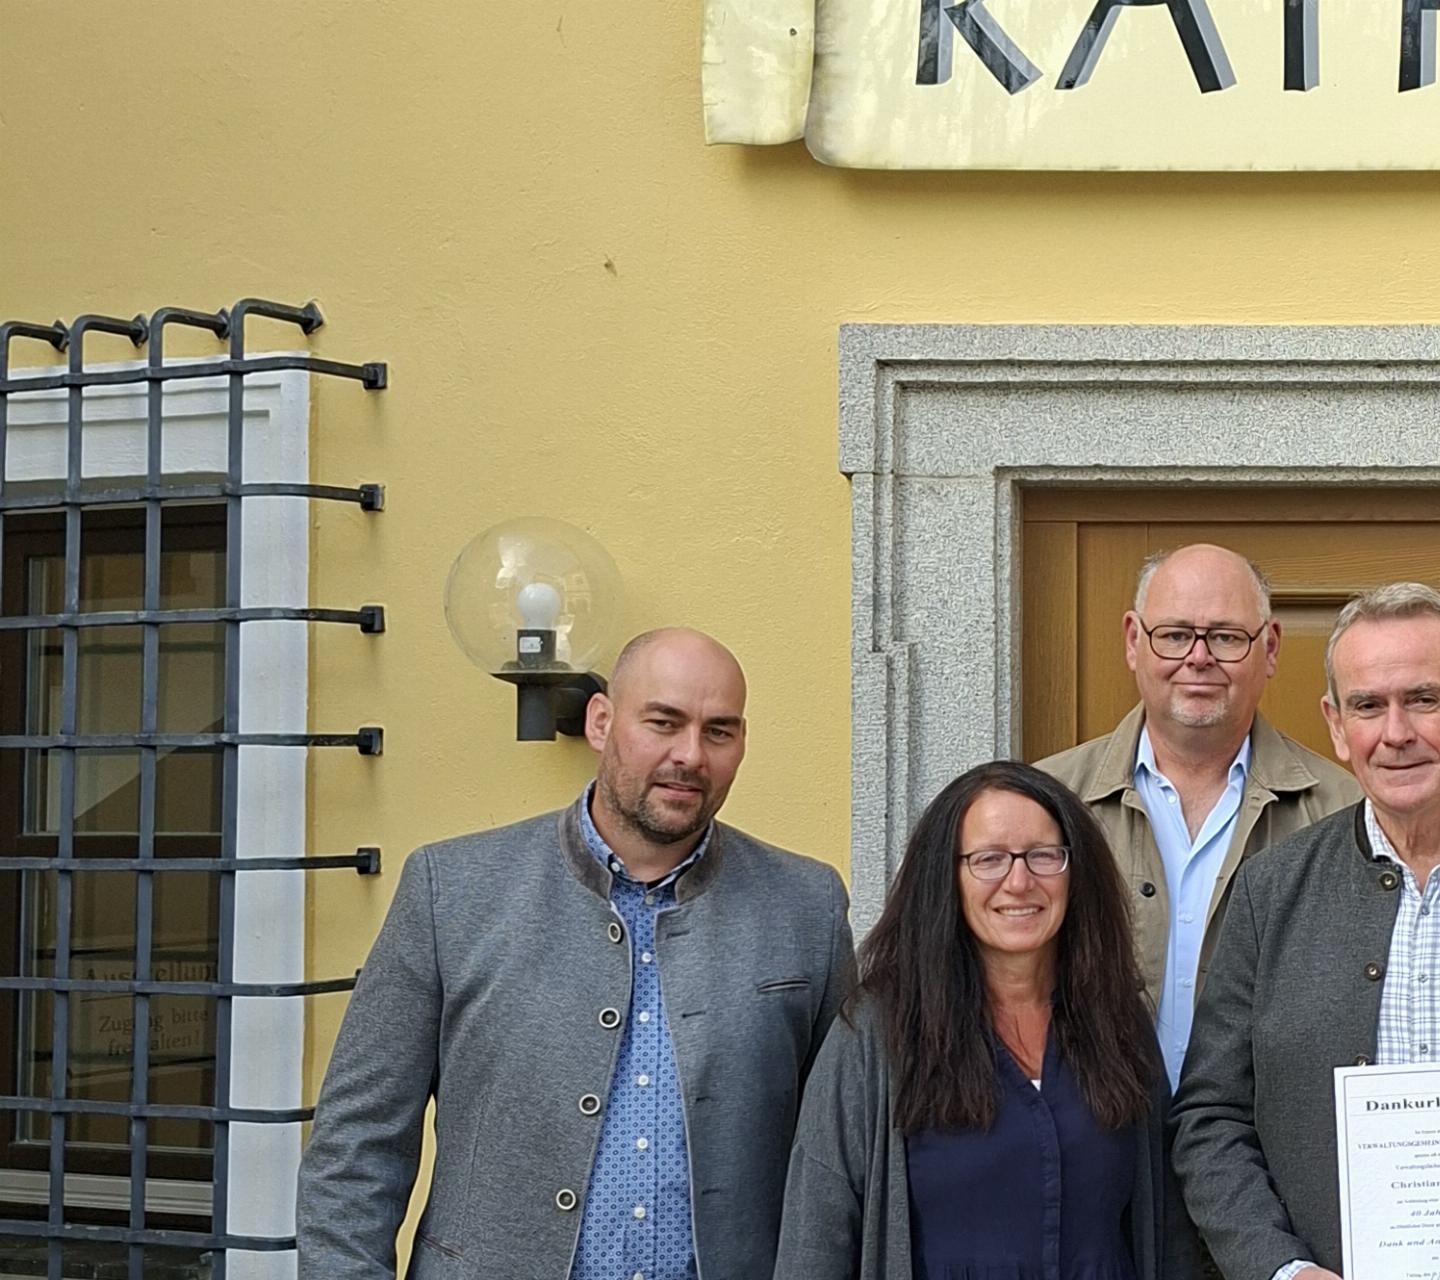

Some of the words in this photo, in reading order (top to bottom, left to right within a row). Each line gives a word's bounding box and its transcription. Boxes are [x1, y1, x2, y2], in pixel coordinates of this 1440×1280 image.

[98, 1015, 164, 1036] Zugg
[1378, 1239, 1404, 1248] Dank
[1407, 1238, 1425, 1246] und
